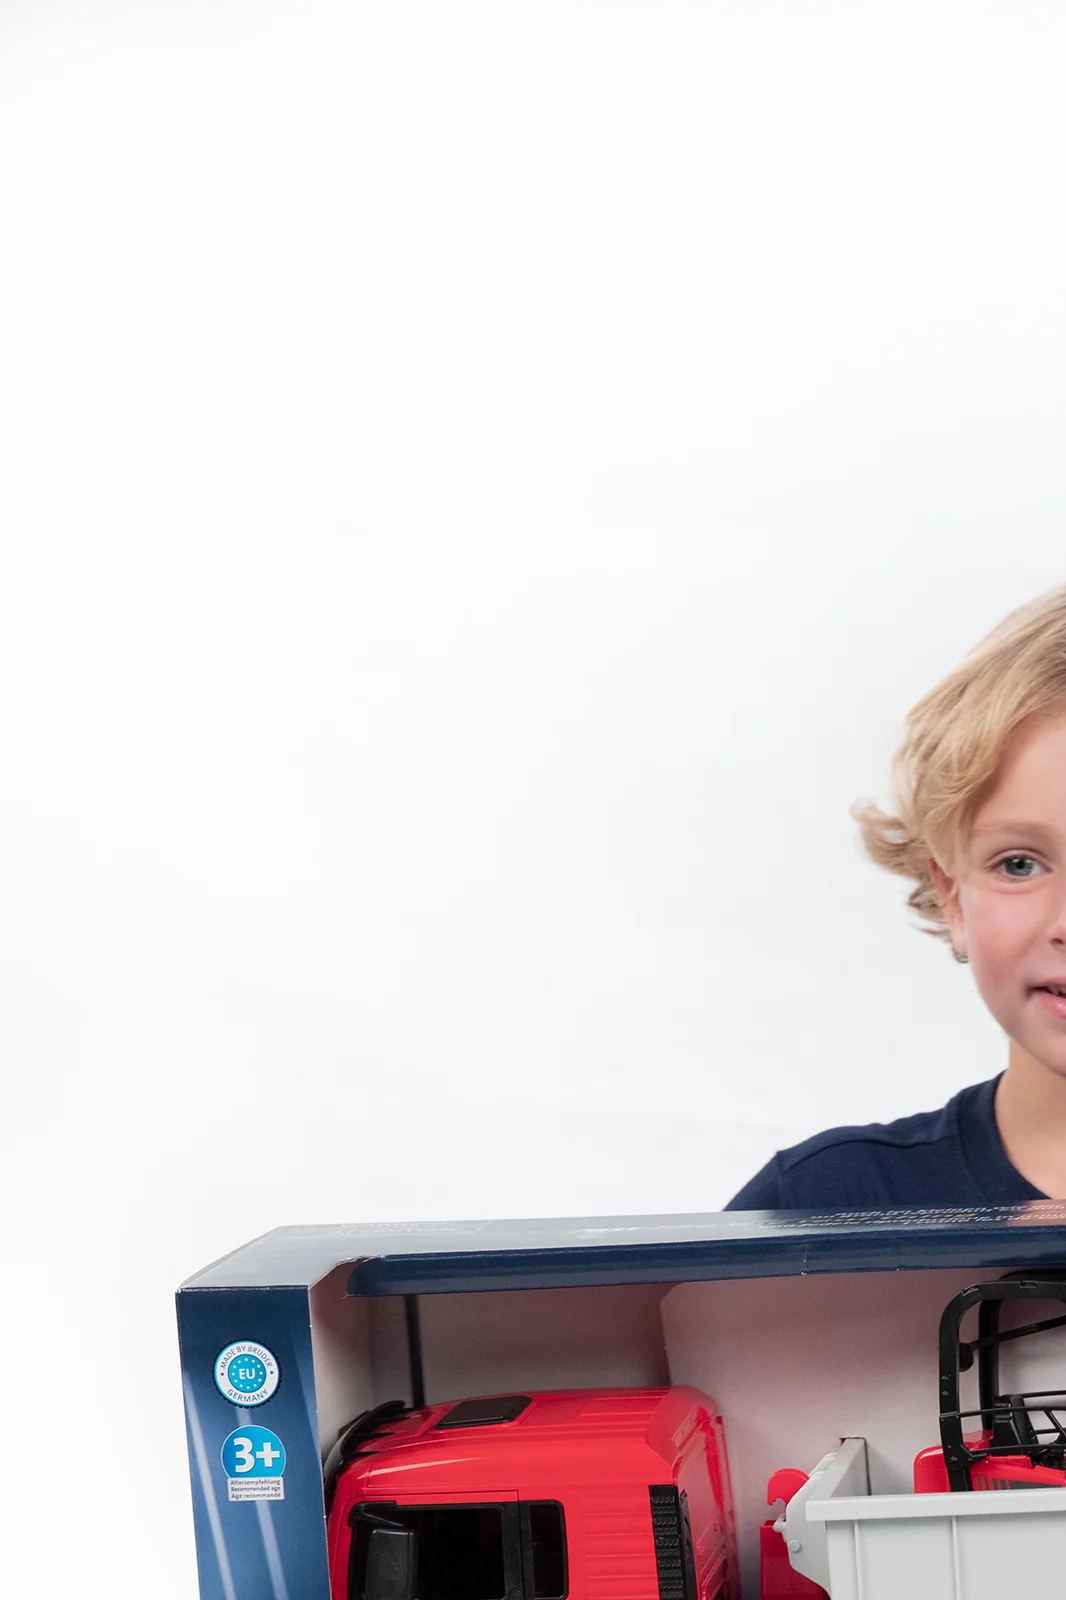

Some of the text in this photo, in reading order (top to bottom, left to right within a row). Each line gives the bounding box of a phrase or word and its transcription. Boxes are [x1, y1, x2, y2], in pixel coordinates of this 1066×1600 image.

[220, 1345, 273, 1369] MADE BY BRUDER
[238, 1368, 256, 1380] EU
[227, 1388, 269, 1402] GERMANY
[233, 1437, 280, 1473] 3+
